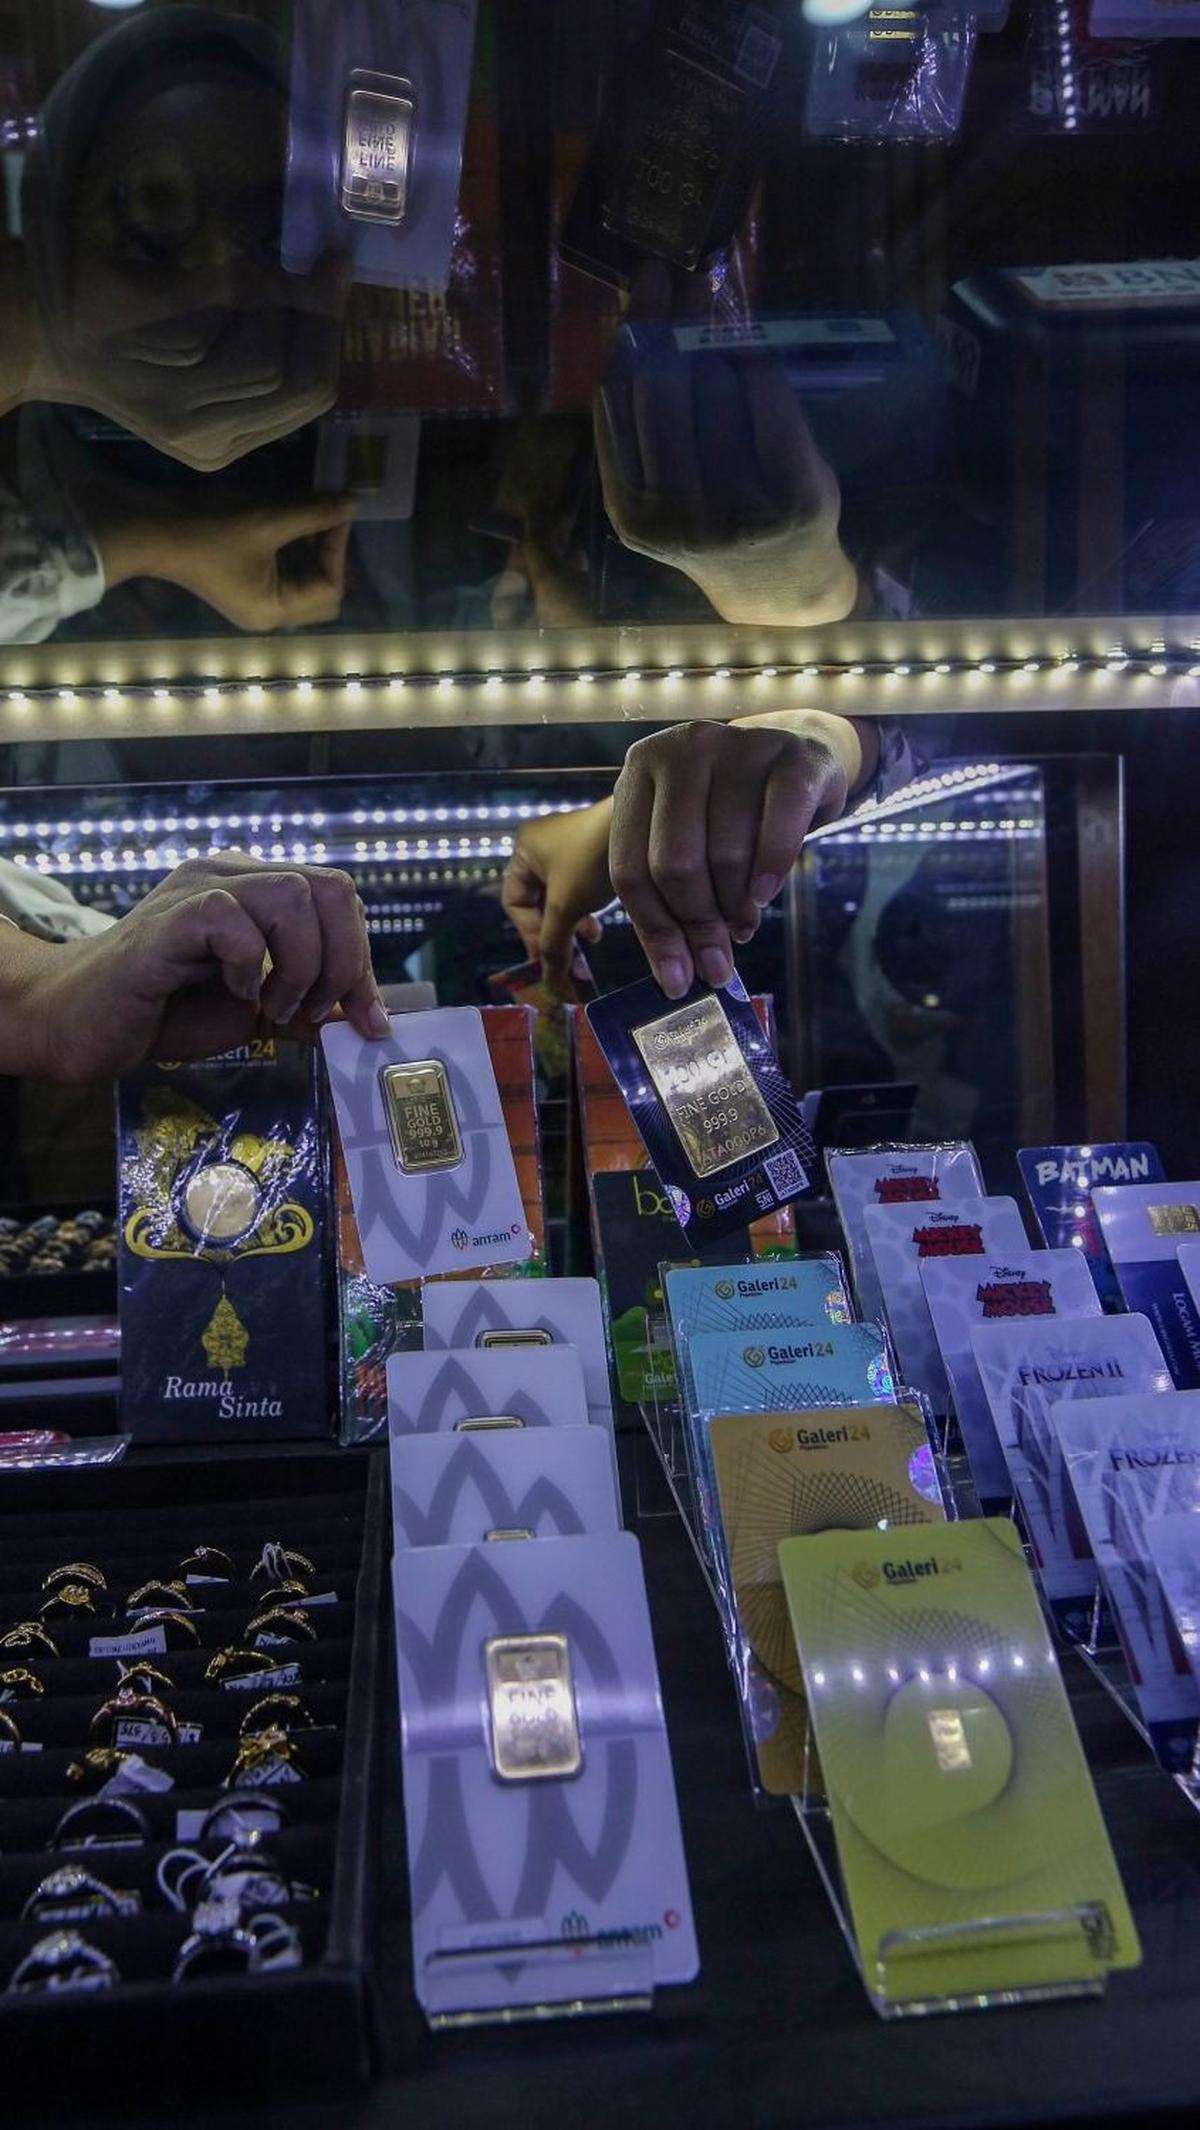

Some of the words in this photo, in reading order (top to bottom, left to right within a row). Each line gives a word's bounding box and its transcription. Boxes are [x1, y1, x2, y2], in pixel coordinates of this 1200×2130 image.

[404, 1103, 440, 1118] FINE
[676, 1097, 708, 1120] FINE
[708, 1080, 746, 1105] GOLD
[407, 1116, 441, 1129] GOLD
[703, 1108, 739, 1134] 999.9
[409, 1125, 443, 1140] 999.9
[1035, 1152, 1150, 1186] BATMAN
[163, 1376, 234, 1398] Rama
[218, 1396, 284, 1419] Sinta
